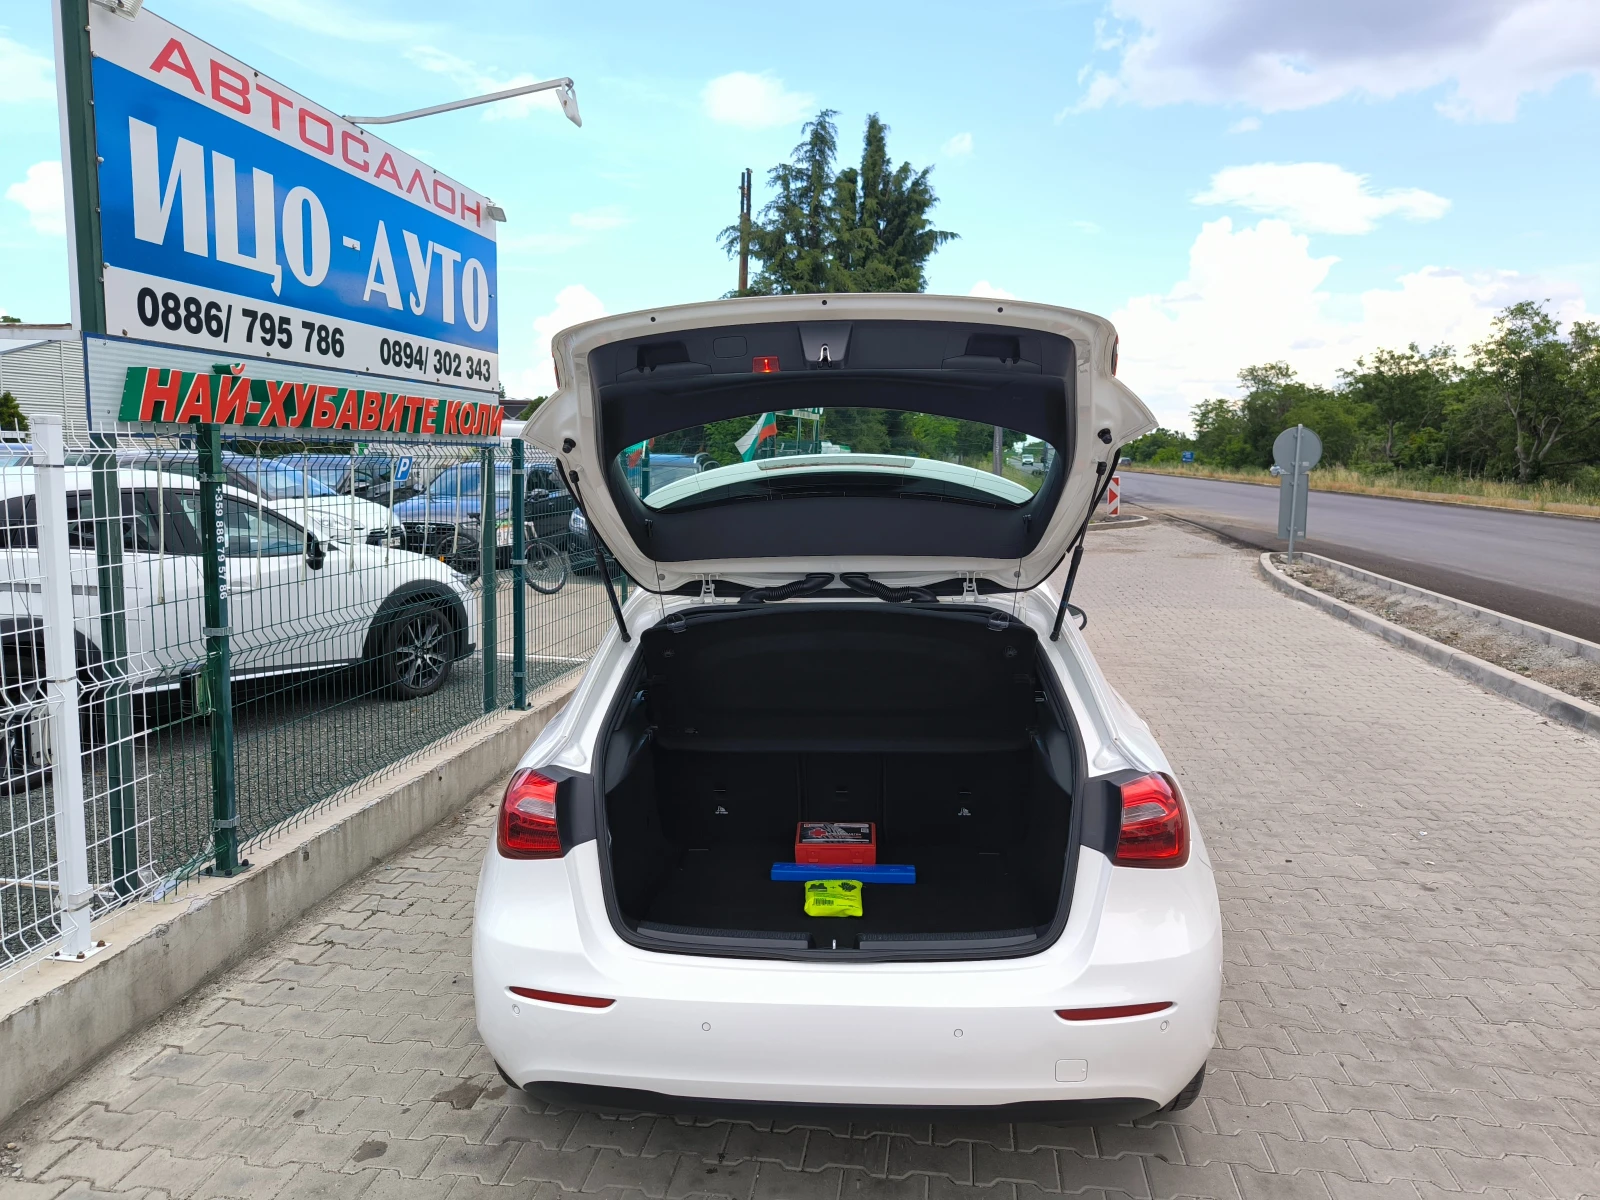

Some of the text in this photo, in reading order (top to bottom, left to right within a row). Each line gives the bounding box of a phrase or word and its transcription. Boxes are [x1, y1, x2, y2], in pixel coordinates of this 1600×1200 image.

[149, 38, 481, 227] АВТОСАЛОН
[137, 287, 491, 382] 0886/ 795 786 0894/ 302 343
[138, 363, 504, 436] НАЙ-ХУБАВИТЕ КОЛИ
[397, 458, 410, 478] P
[215, 486, 228, 600] +359 886 79 57 86
